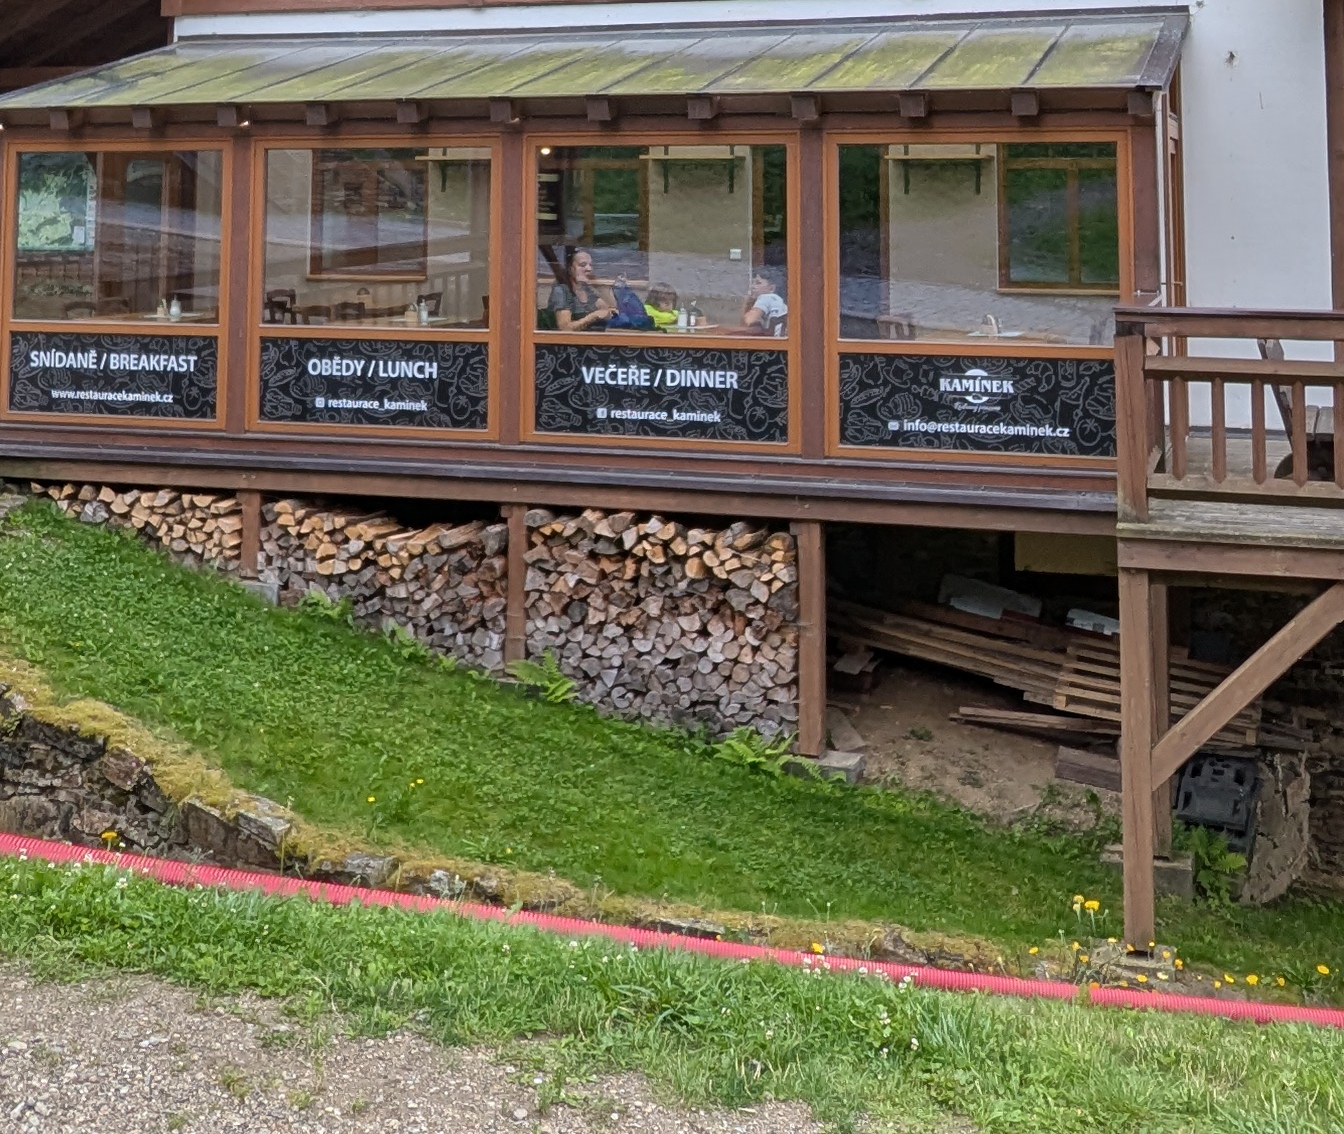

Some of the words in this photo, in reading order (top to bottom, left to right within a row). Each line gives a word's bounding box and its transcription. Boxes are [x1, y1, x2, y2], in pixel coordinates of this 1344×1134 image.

[30, 349, 98, 369] SNÍDANĚ
[109, 353, 198, 372] BREAKFAST
[307, 356, 365, 377] OBĚDY
[378, 360, 438, 379] LUNCH
[581, 364, 650, 386] VEČEŘE
[666, 369, 739, 389] DINNER
[939, 377, 1015, 394] KAMÍNEK
[51, 388, 174, 404] www.restauracekaminek.cz
[327, 398, 428, 411] restaurace_kaminek
[610, 408, 721, 423] restaurace_kaminek
[903, 419, 1071, 438] info@restauracekaminek.cz
